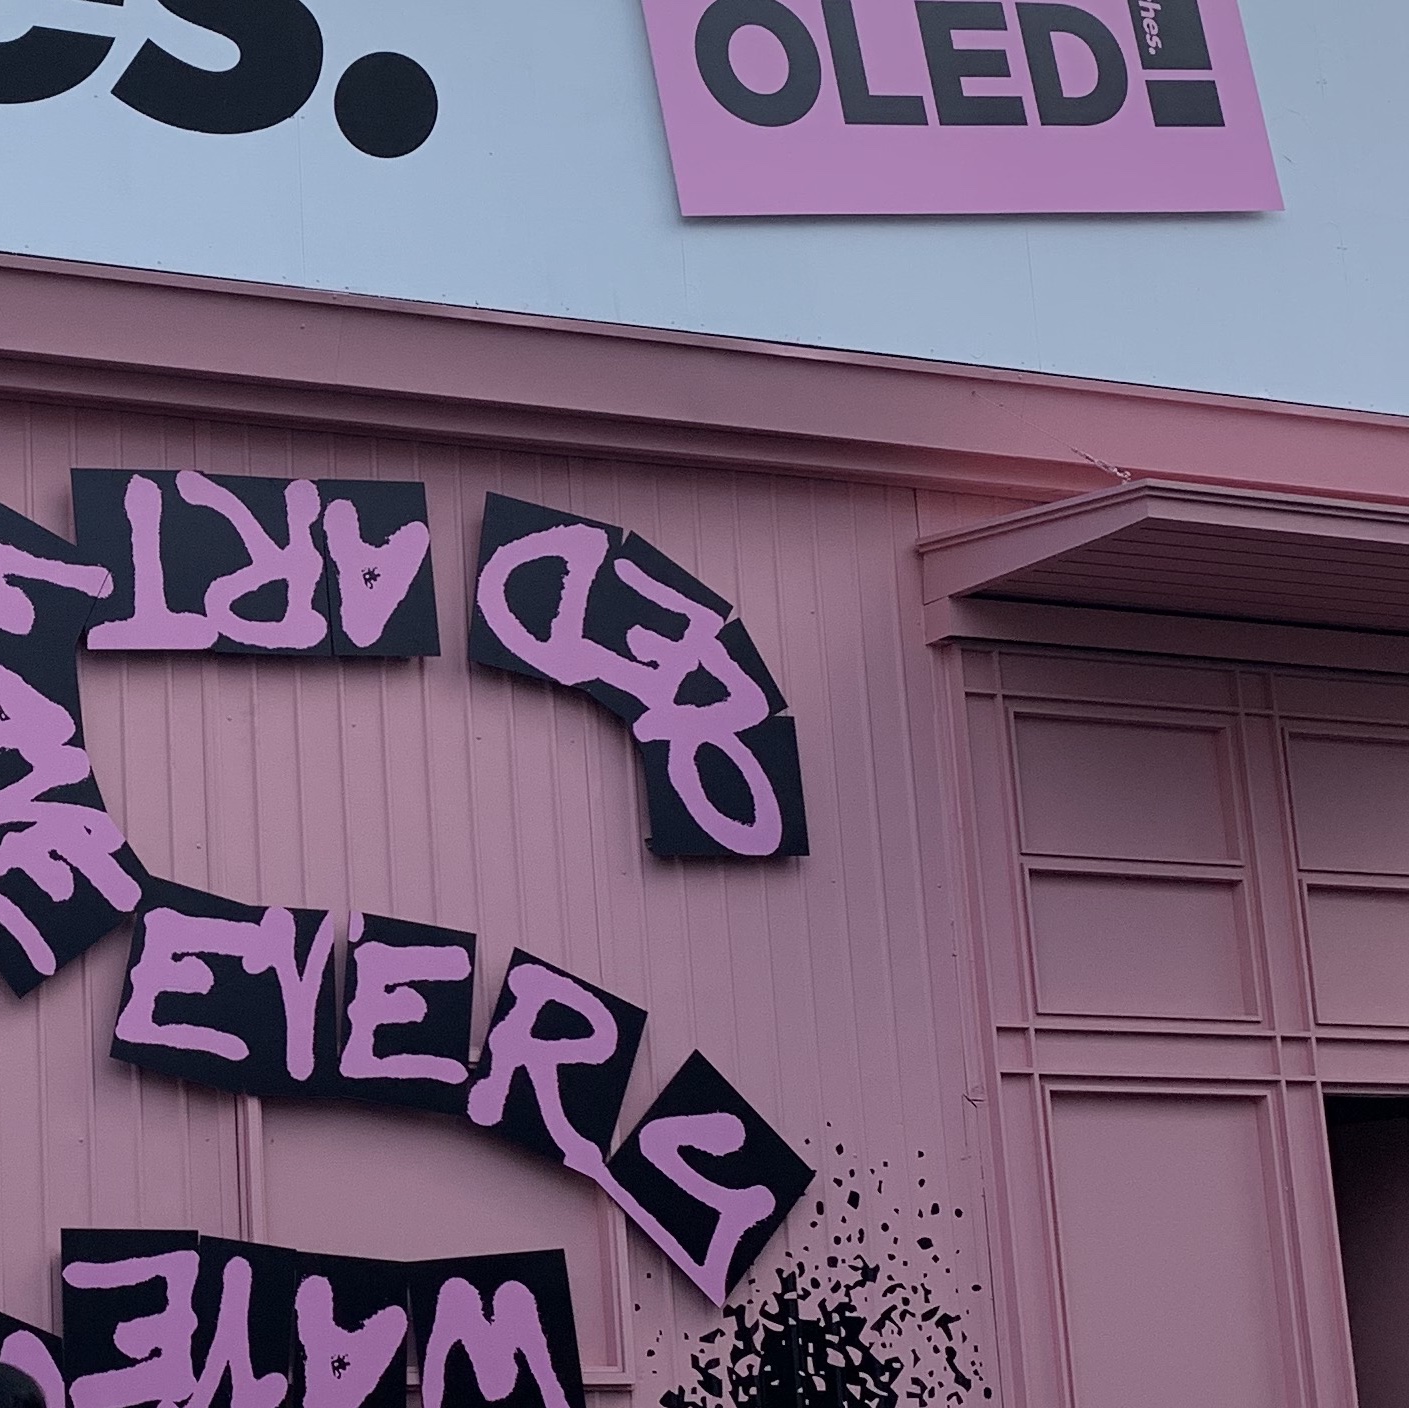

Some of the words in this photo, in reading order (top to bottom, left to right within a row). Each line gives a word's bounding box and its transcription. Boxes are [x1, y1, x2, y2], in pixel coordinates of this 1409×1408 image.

[1138, 0, 1163, 55] hes.
[87, 470, 430, 651] ART
[477, 523, 783, 856] OLED
